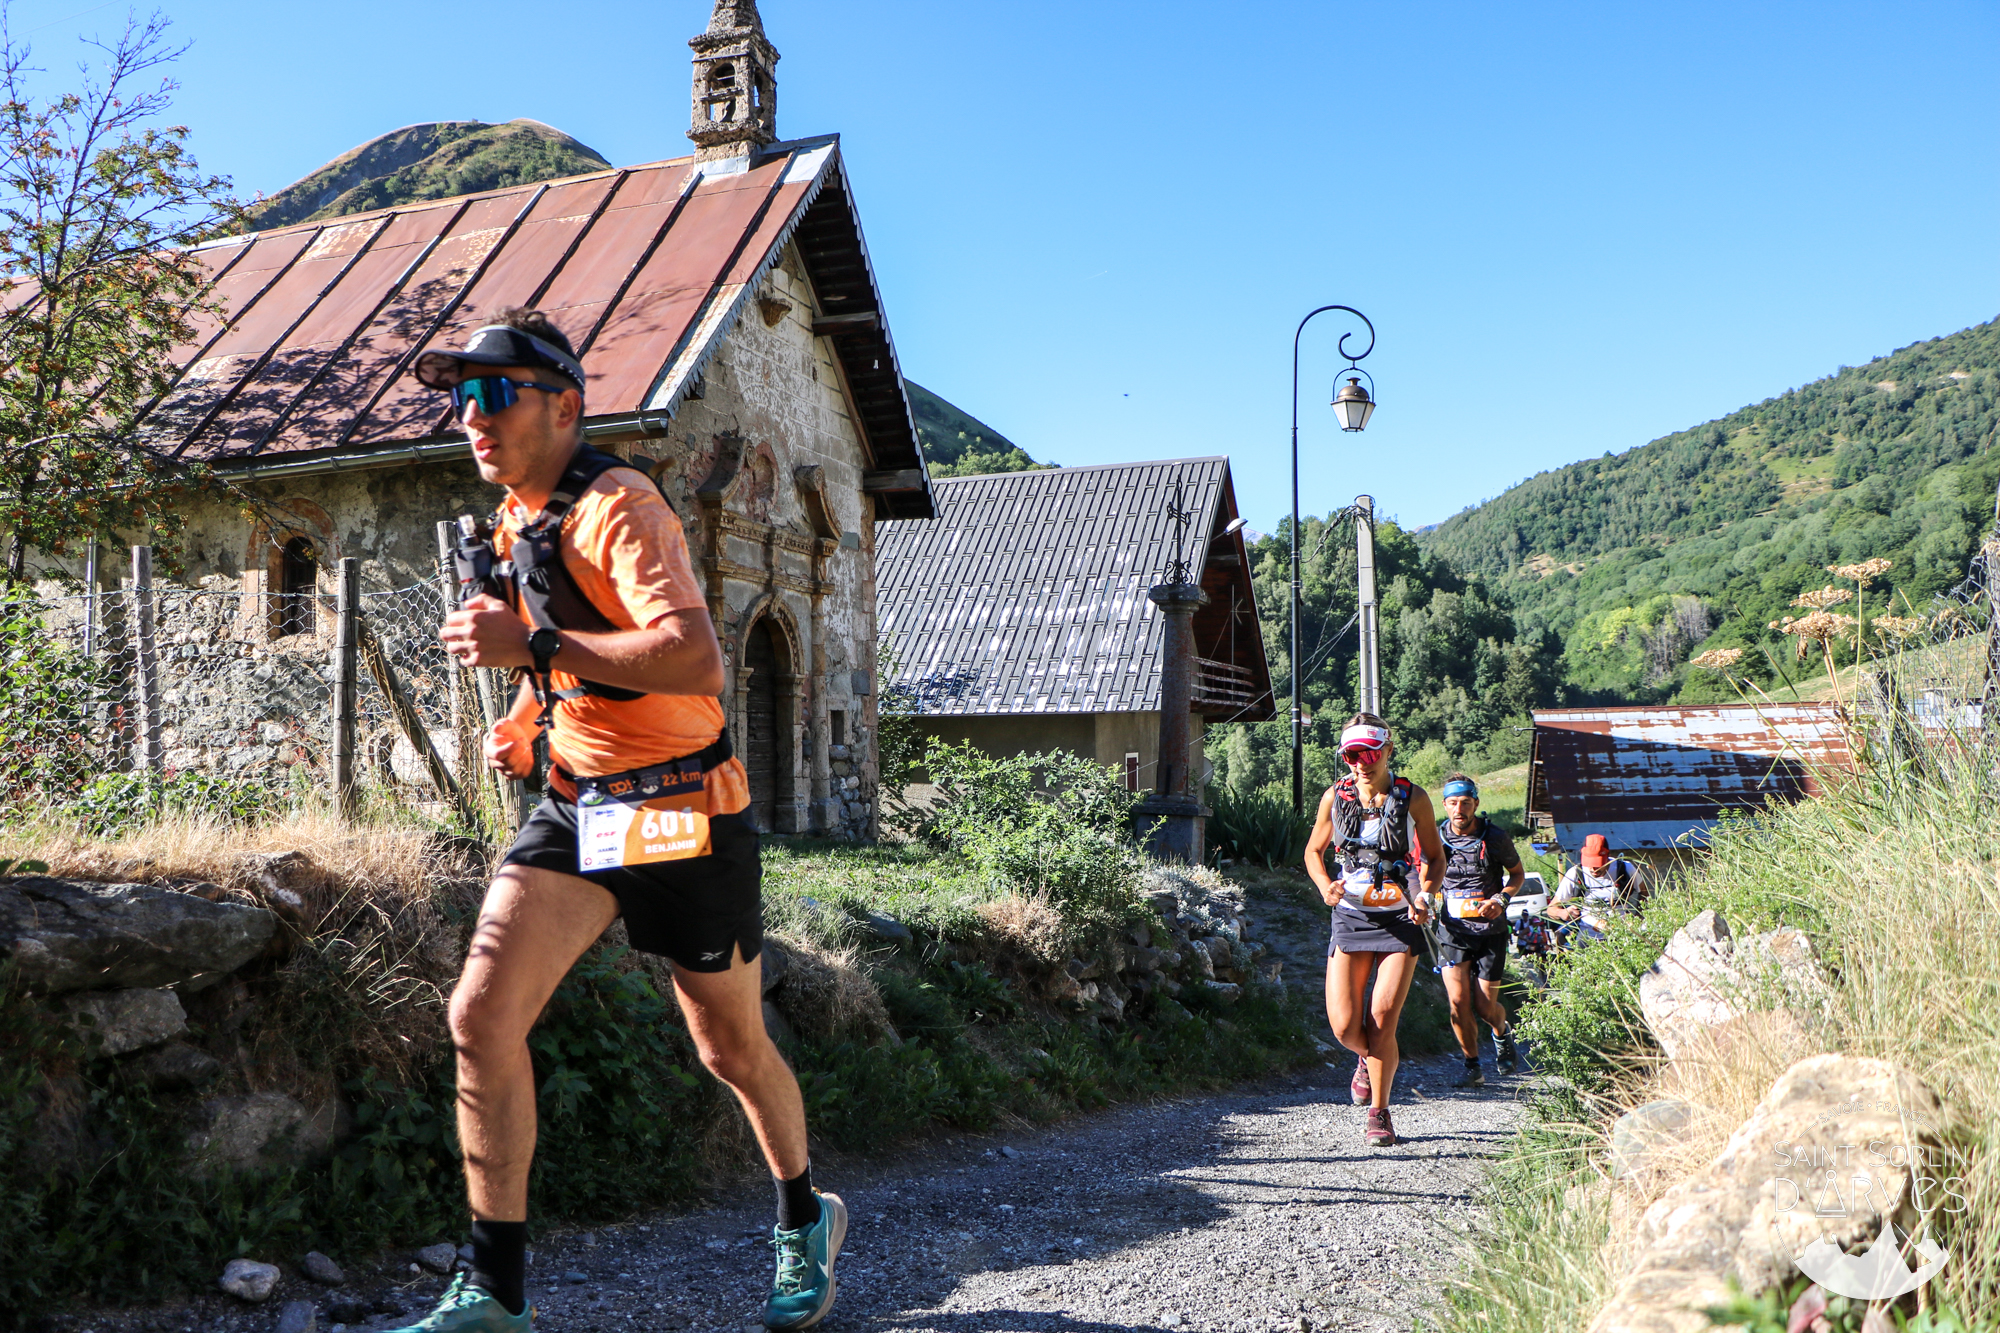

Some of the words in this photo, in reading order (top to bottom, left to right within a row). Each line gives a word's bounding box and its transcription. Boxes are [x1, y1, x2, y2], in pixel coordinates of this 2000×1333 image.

[661, 773, 679, 787] 22
[680, 771, 701, 784] km
[641, 806, 695, 840] 601
[645, 838, 697, 854] BENJAMIN
[1370, 888, 1397, 900] 672
